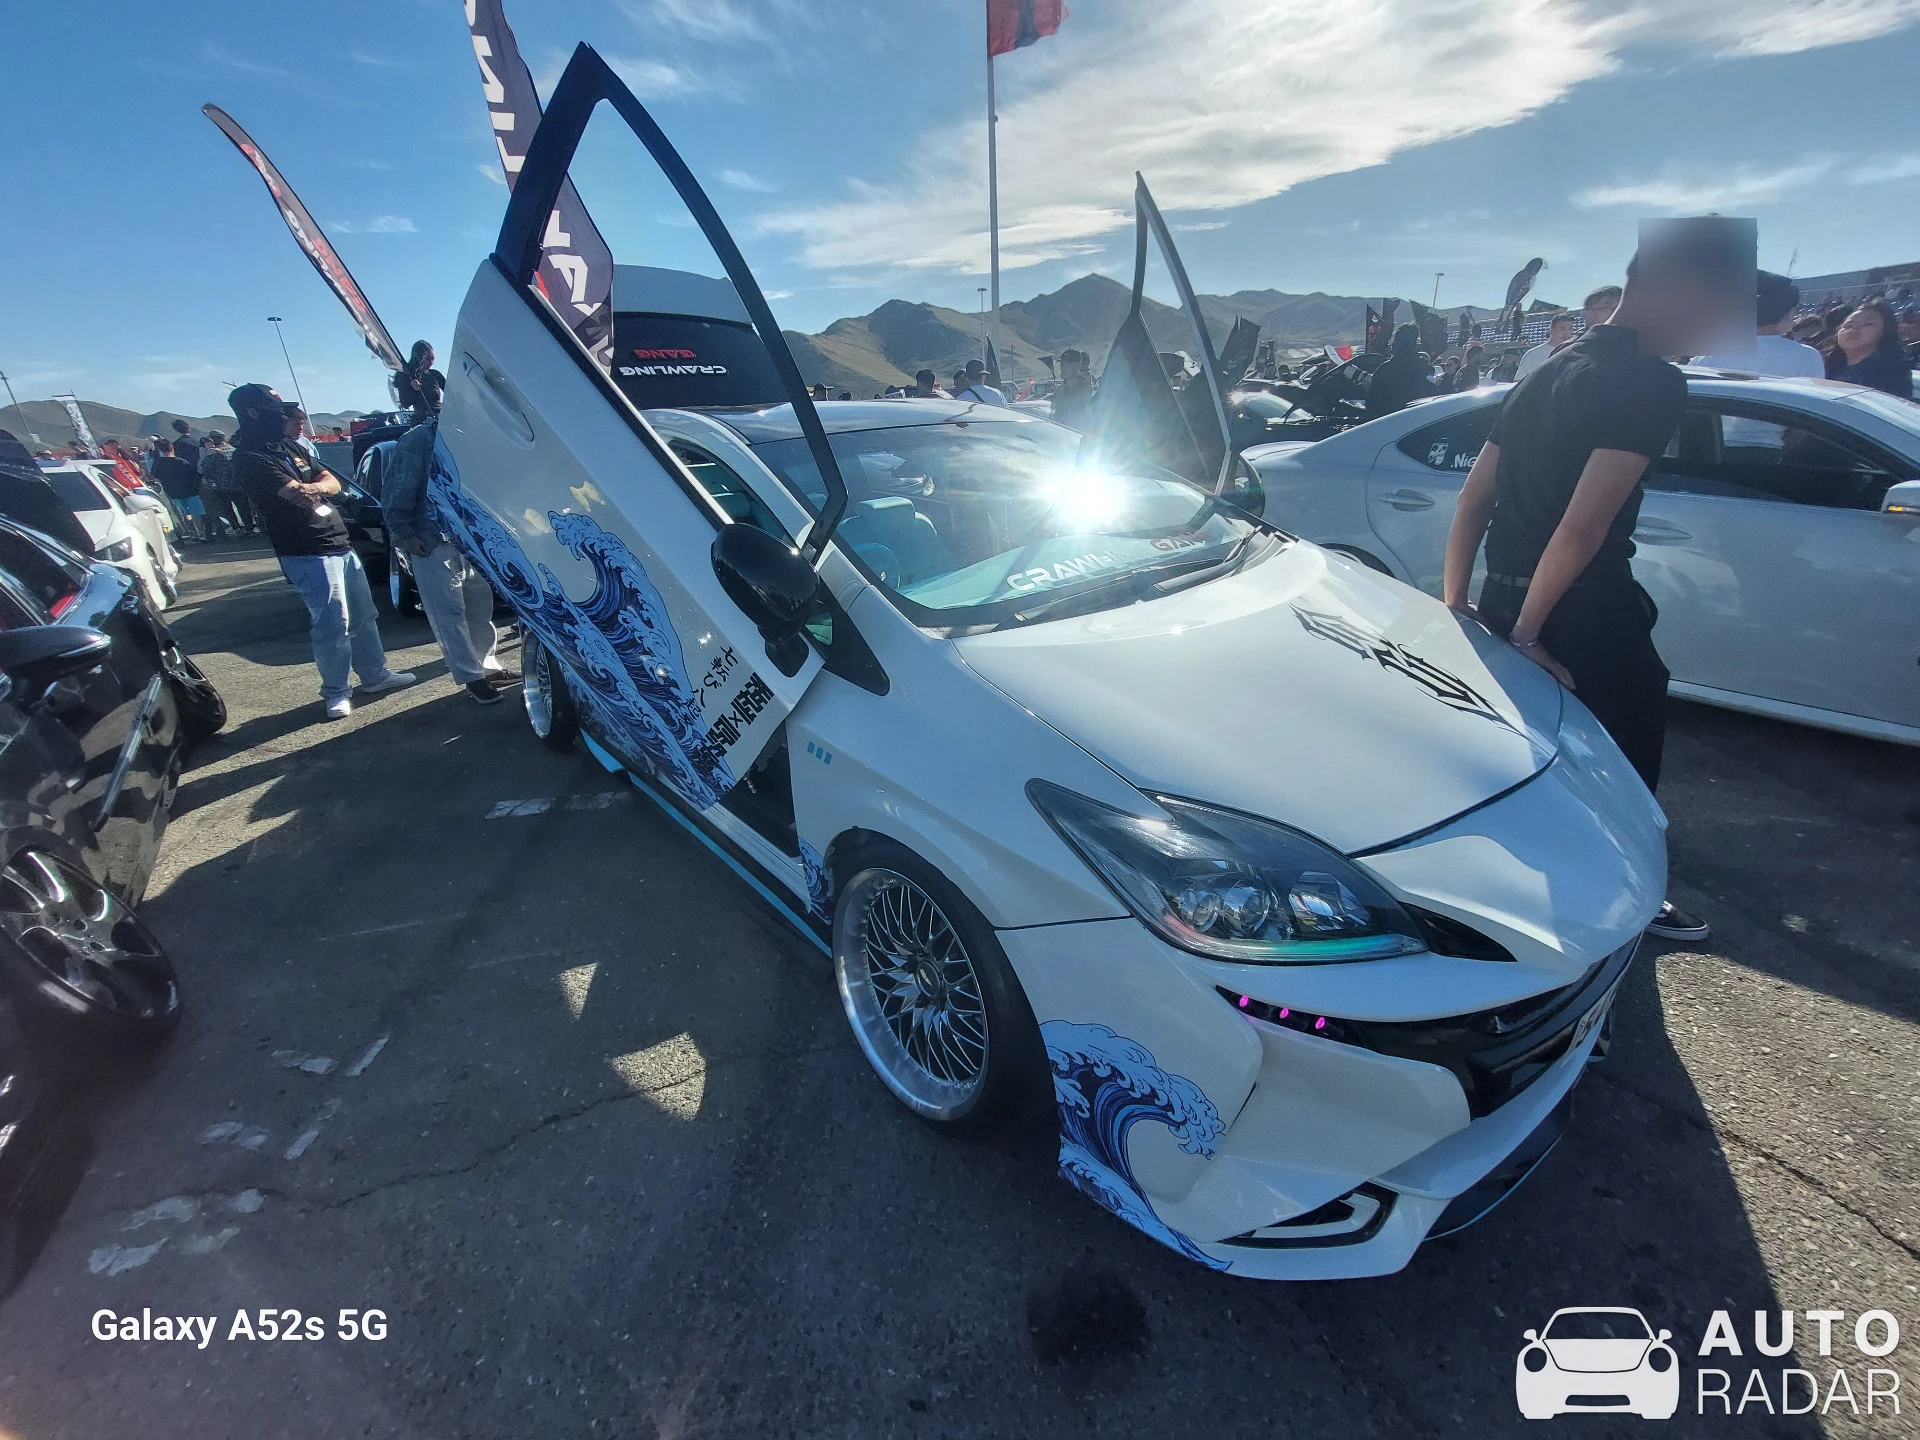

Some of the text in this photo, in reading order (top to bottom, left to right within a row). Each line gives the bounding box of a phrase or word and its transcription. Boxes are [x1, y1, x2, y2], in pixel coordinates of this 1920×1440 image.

[634, 349, 696, 359] GANG
[618, 364, 728, 376] CRAWLING
[1006, 548, 1136, 591] CRAWLI
